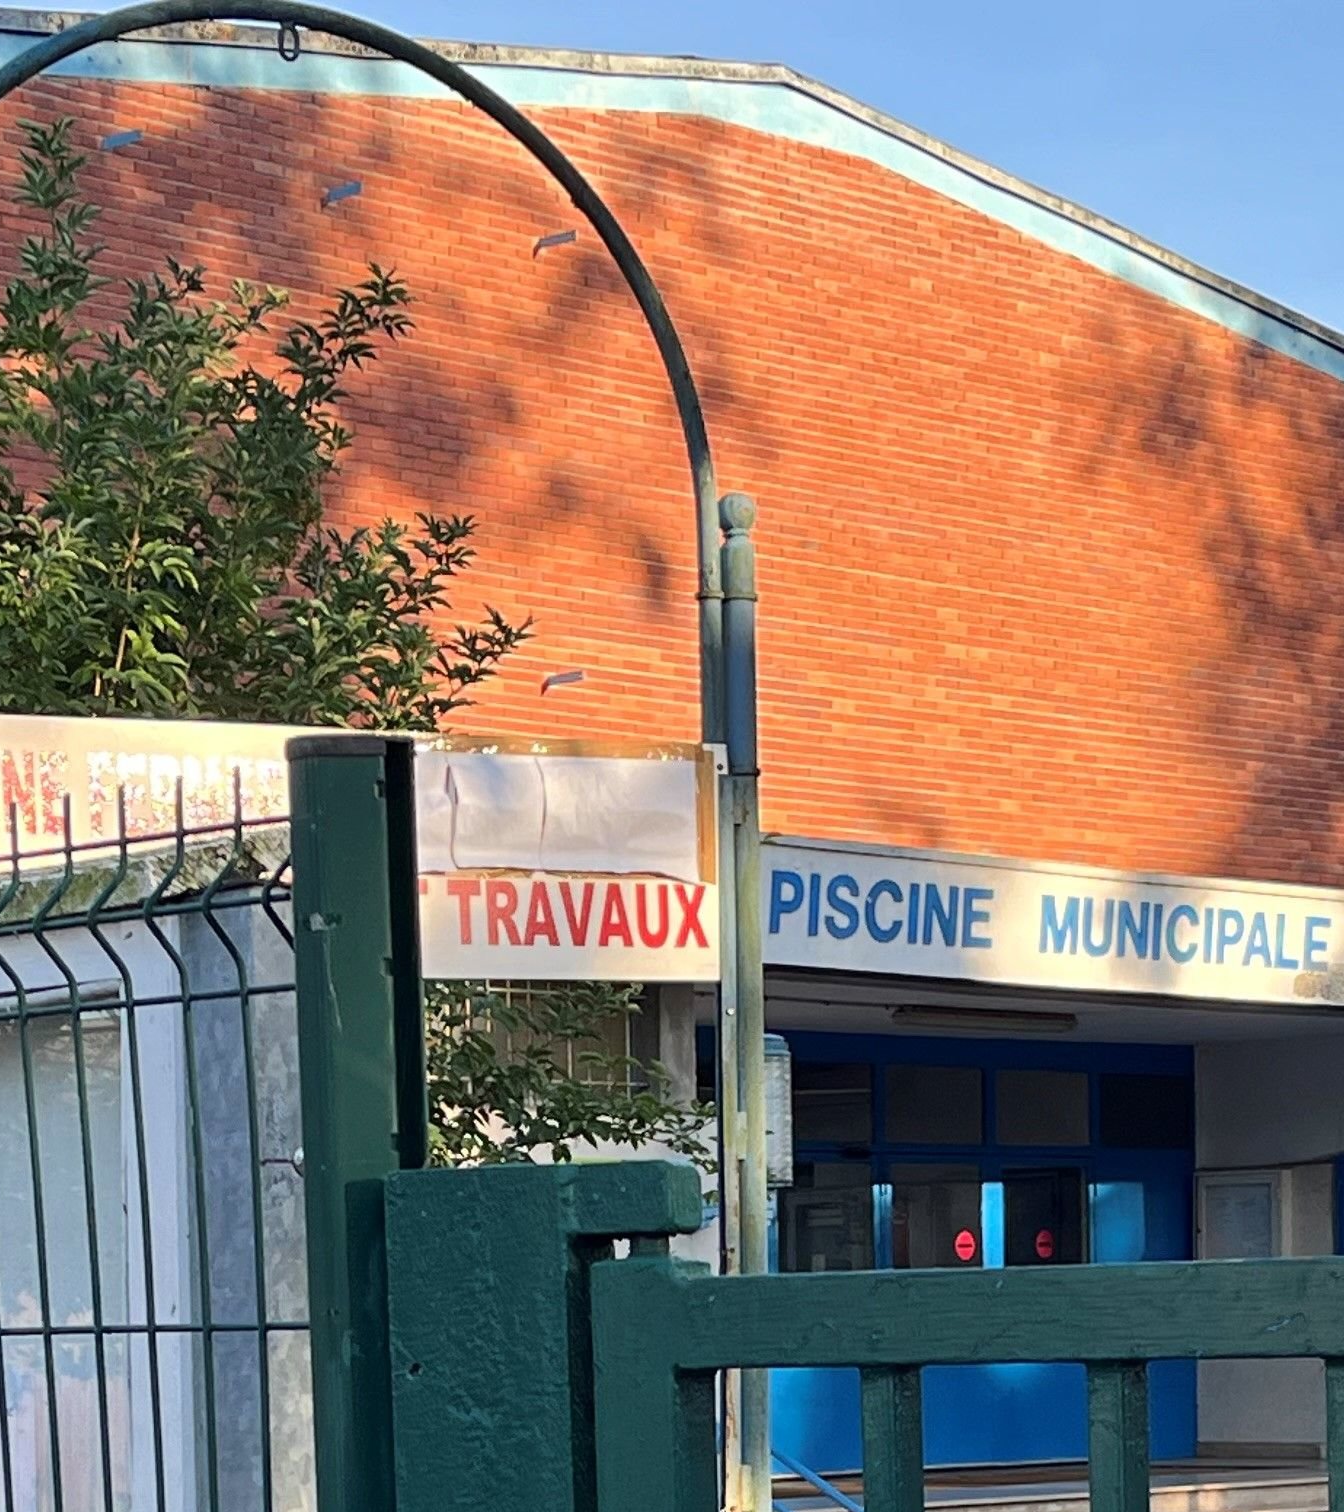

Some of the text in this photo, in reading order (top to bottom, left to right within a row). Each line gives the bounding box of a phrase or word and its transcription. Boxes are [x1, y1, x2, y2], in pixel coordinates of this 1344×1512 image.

[447, 879, 710, 948] TRAVAUX
[768, 870, 994, 948] PISCINE
[1039, 895, 1333, 972] MUNICIPALE
